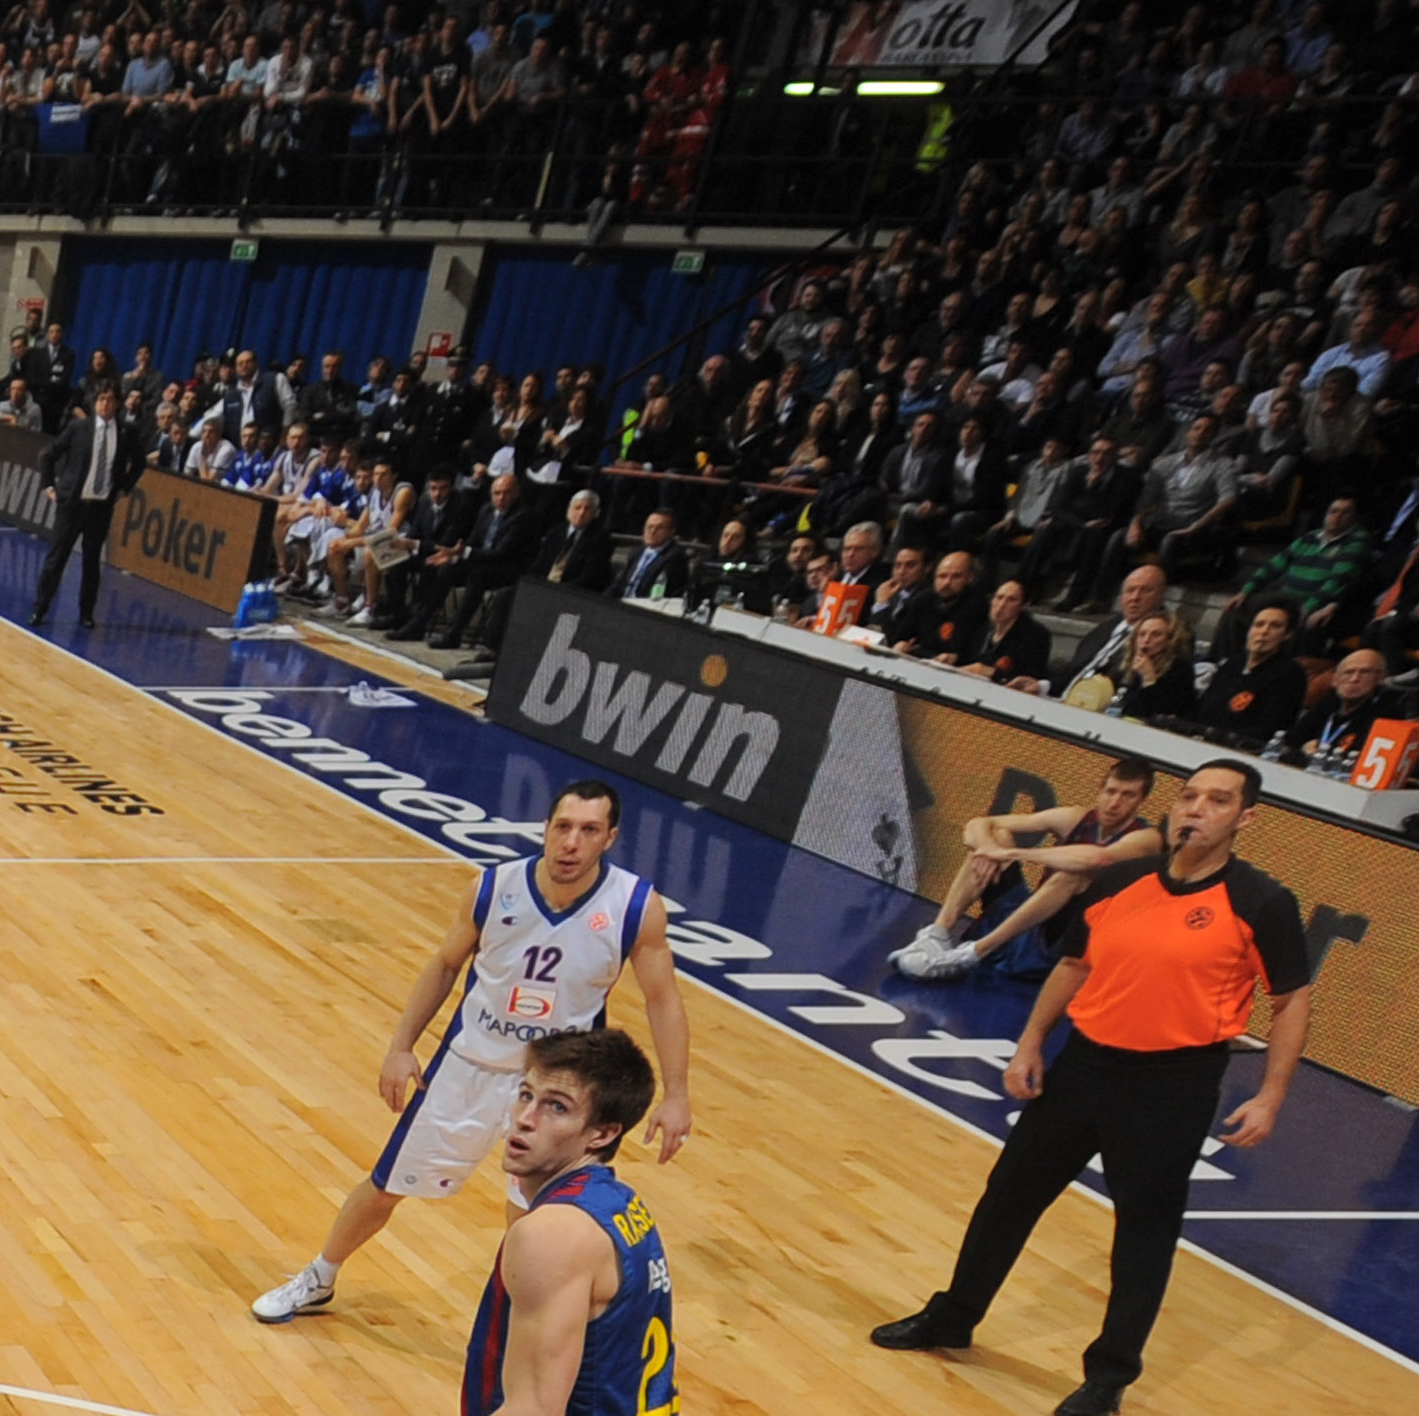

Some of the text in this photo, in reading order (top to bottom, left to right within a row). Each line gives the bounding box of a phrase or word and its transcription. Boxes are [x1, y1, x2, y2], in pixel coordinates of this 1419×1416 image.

[120, 486, 227, 580] Poker
[517, 612, 782, 802] bwin
[169, 686, 545, 868] bennet
[523, 944, 563, 984] 12
